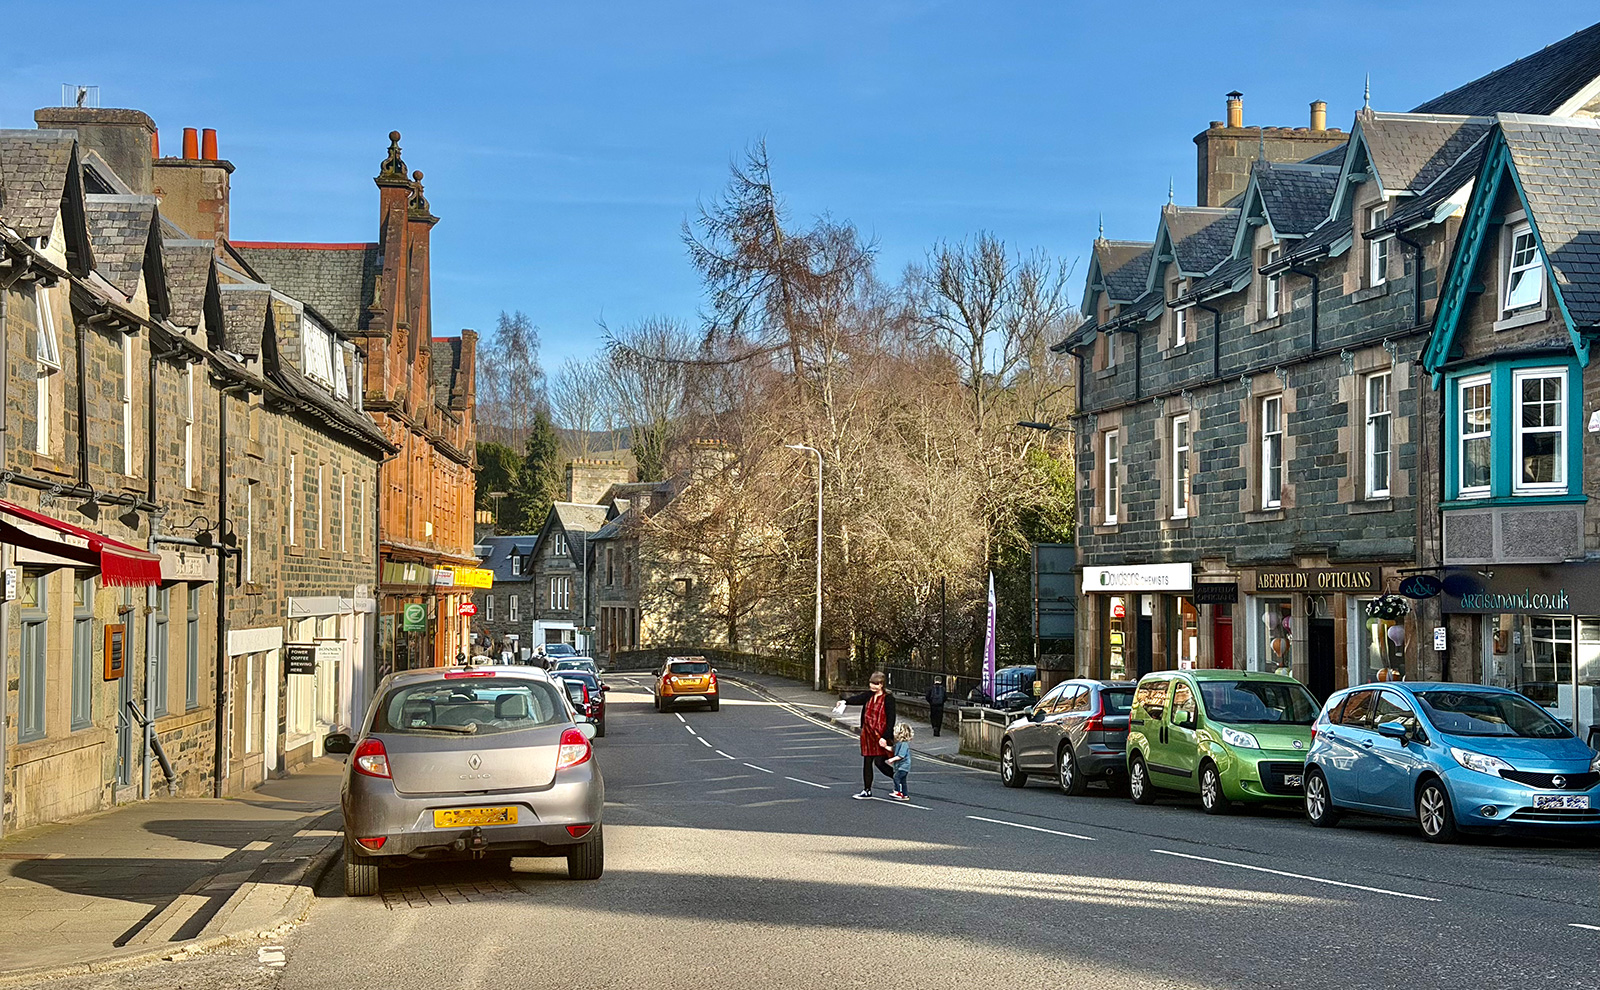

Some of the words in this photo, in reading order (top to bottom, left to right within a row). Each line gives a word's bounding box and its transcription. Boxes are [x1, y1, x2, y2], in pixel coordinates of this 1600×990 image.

[1258, 573, 1309, 588] ABERFELDY
[1318, 571, 1371, 588] OPTICIANS
[1460, 588, 1569, 610] artisanand.co.uk
